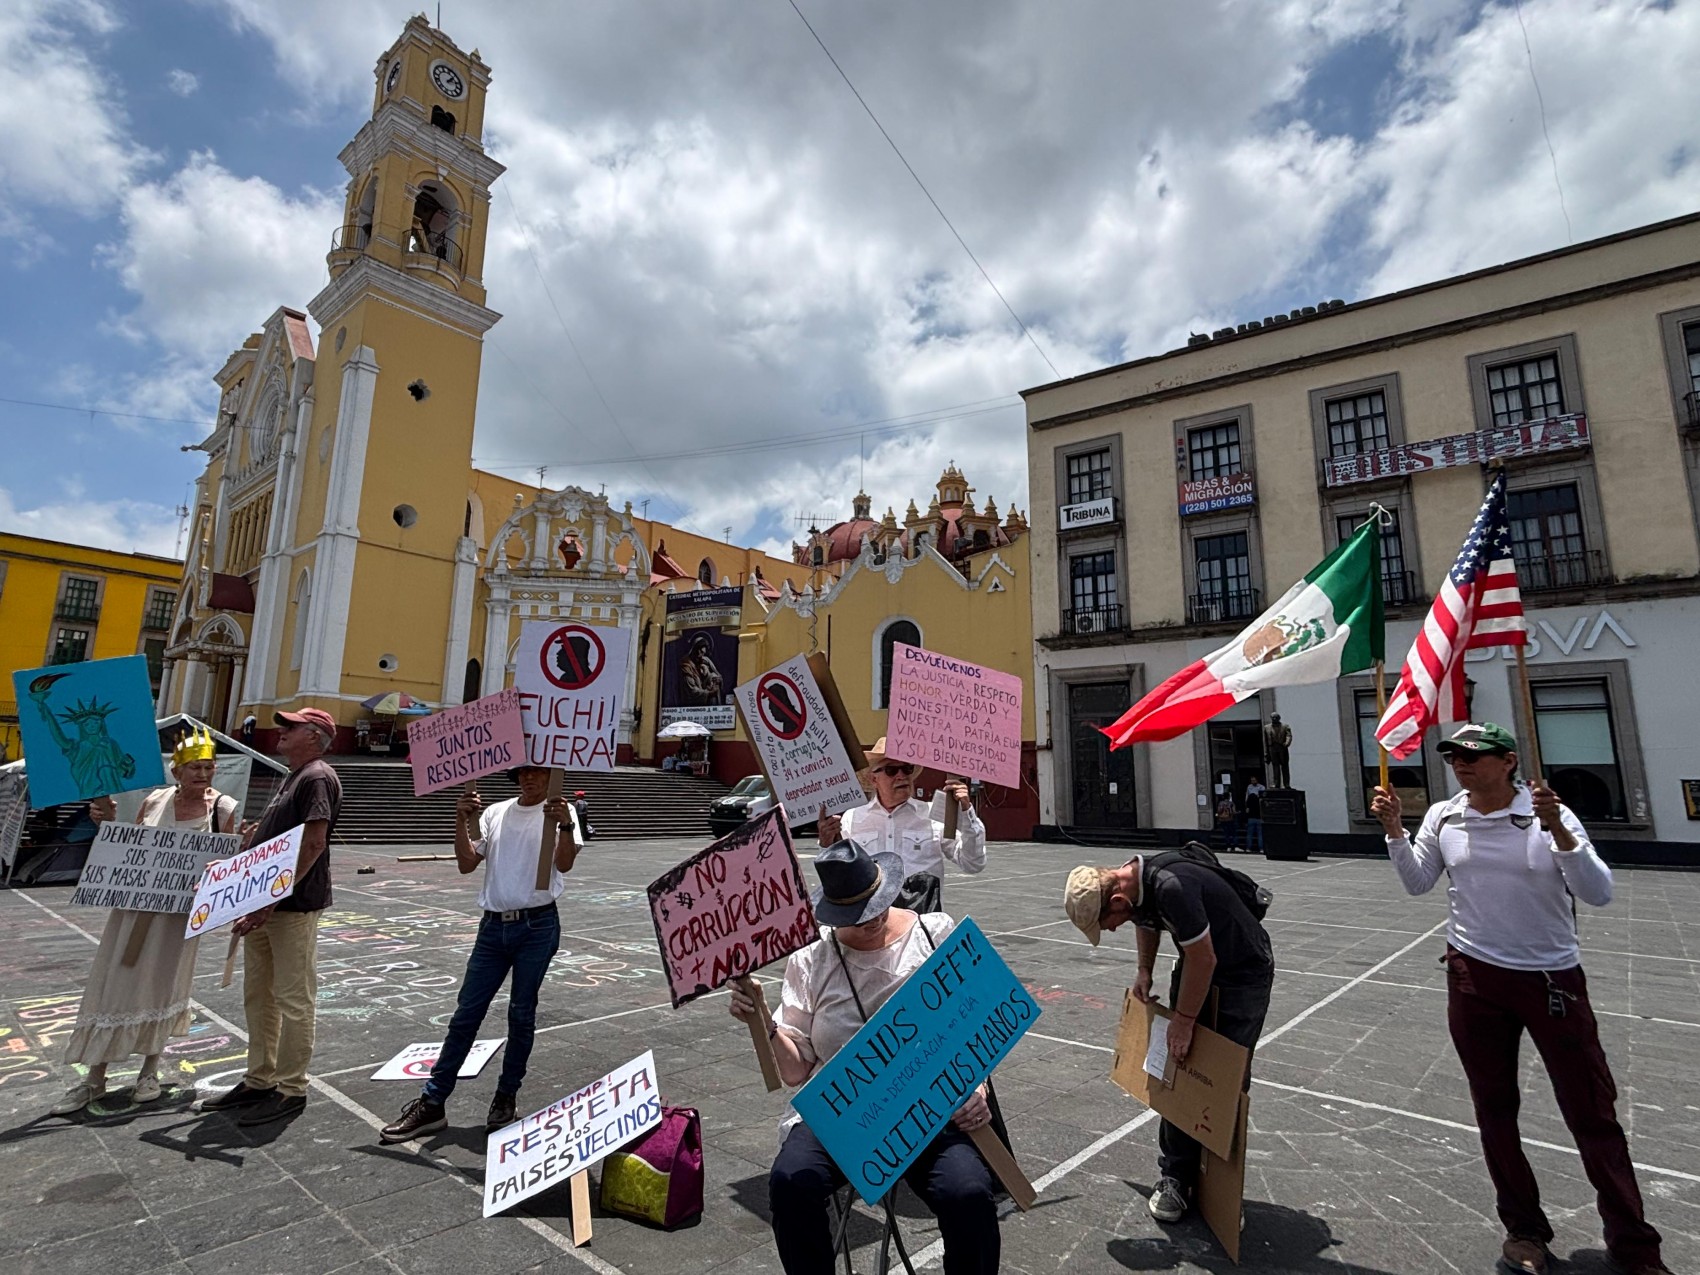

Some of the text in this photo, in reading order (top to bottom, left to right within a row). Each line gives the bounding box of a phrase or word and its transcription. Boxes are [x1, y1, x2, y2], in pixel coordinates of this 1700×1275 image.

[1184, 477, 1230, 492] VISAS &
[1185, 481, 1252, 502] MIGRACIÓN
[1063, 506, 1110, 522] TRIBUNA
[1185, 494, 1253, 514] (228) 501 2365
[900, 664, 919, 677] LA
[900, 693, 992, 729] HONESTIDAD A
[950, 693, 997, 715] VERDAD
[1002, 708, 1010, 720] Y
[436, 721, 493, 759] JUNTOS
[809, 720, 831, 749] bully
[896, 722, 1007, 763] VIVA LA DIVERSIDAD
[897, 708, 953, 734] NUESTRA
[964, 725, 1001, 746] PATRIA
[426, 741, 512, 786] RESISTIMOS
[783, 768, 793, 781] 34
[801, 755, 833, 775] convicto
[895, 739, 998, 777] Y SU BIENESTAR
[826, 769, 850, 788] sexual
[798, 804, 808, 817] es
[101, 825, 238, 856] DENME SUS CANSADOS
[227, 834, 291, 877] APOYAMOS
[122, 848, 198, 871] SUS POBRES
[242, 869, 251, 880] A
[695, 854, 726, 897] NO
[81, 864, 196, 891] SUS MASAS HACINA
[210, 865, 279, 912] TRUMP
[70, 887, 130, 908] ANHELANDO
[130, 891, 177, 912] RESPIRAR
[712, 941, 750, 988] NO
[820, 933, 982, 1118] HANDS OFF!!
[857, 1104, 886, 1131] VIVA
[886, 1033, 948, 1099] DEMOCRACIA
[861, 988, 1032, 1187] QUITA TUS MANOS
[499, 1067, 652, 1164] RESPETA
[491, 1094, 661, 1205] PAISES VECINOS
[544, 1122, 591, 1155] A LOS
